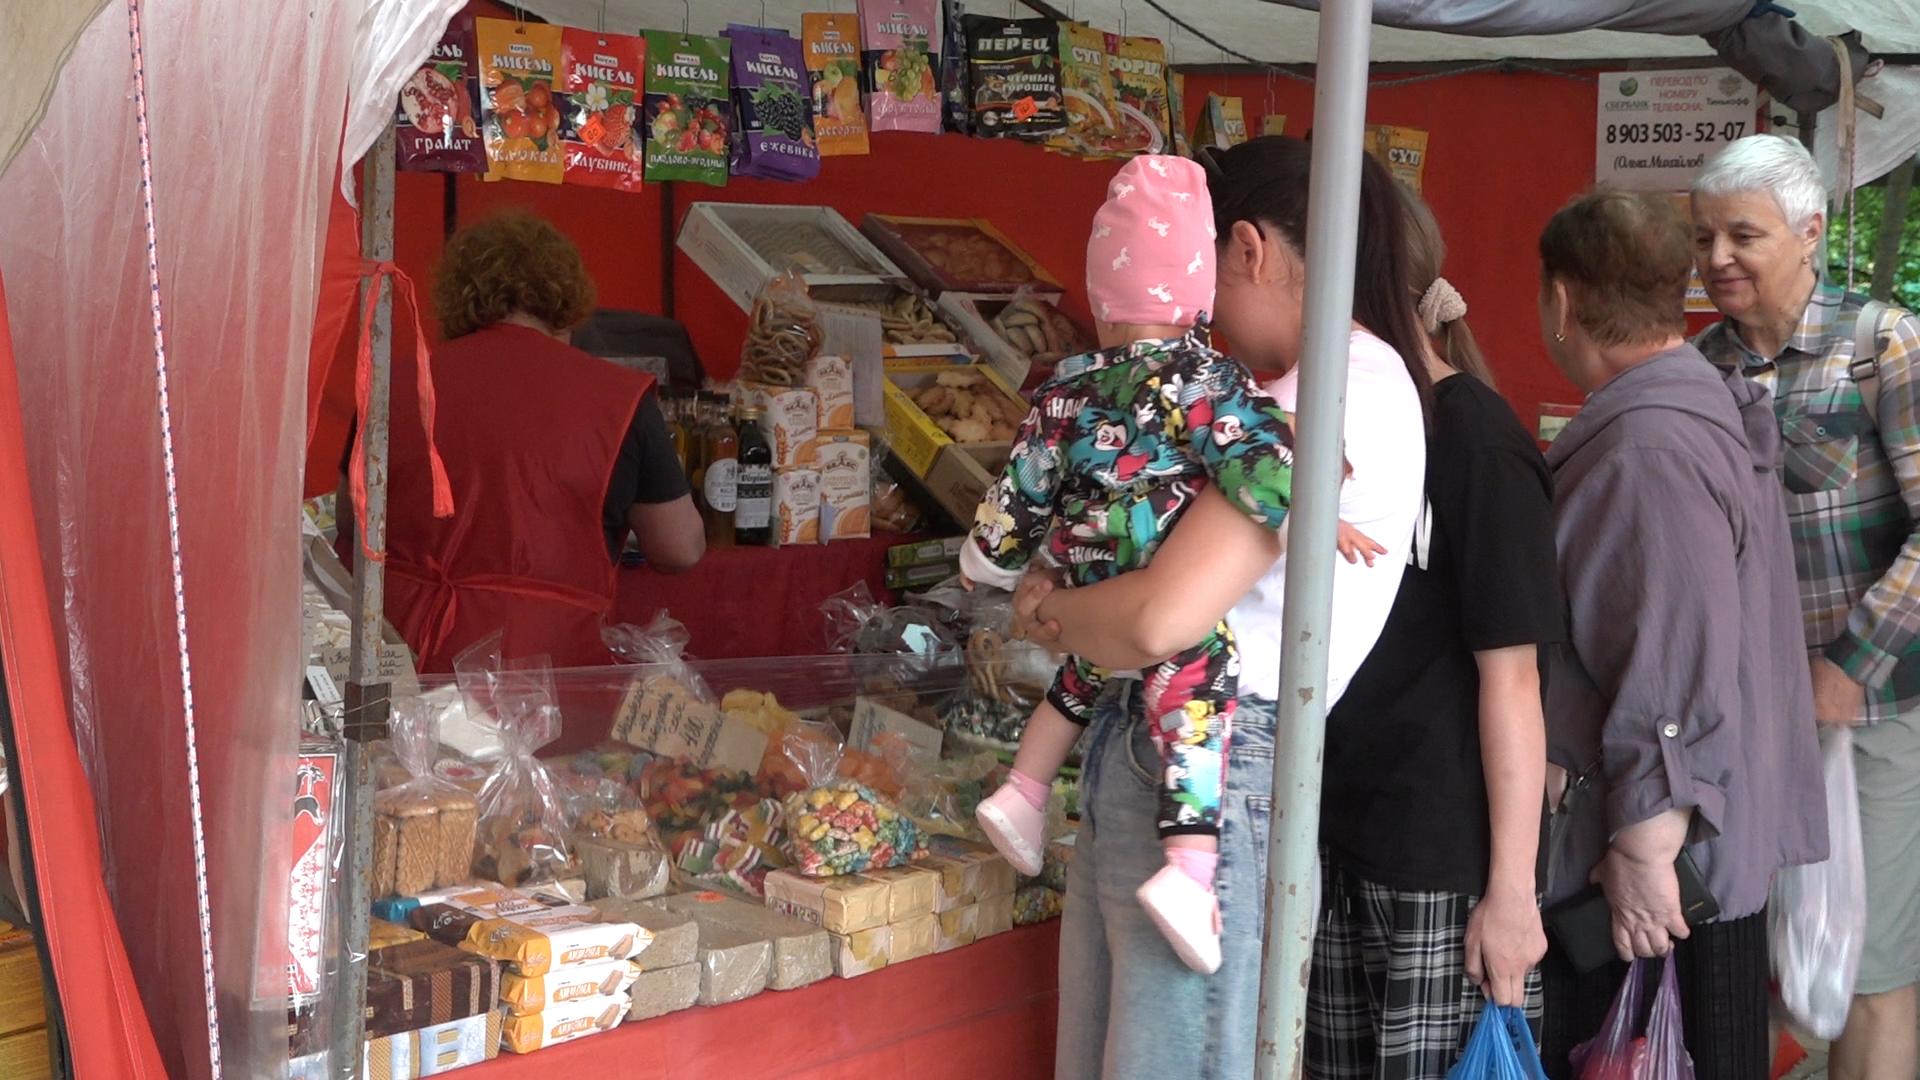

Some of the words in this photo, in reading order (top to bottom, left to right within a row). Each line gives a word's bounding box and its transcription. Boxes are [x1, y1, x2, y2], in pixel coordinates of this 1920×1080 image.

[811, 42, 855, 54] КИСЕЛЬ
[978, 38, 1051, 52] ПЕРЕЦ
[493, 54, 552, 72] КИСЕЛЬ
[575, 63, 635, 85] КИСЕЛЬ
[656, 63, 719, 81] КИСЕЛЬ
[746, 61, 799, 79] КИСЕЛЬ
[1651, 76, 1691, 87] ПЕРЕВОД
[1693, 75, 1708, 84] ПО
[1659, 89, 1698, 99] НОМЕРУ
[1605, 102, 1649, 110] СБЕРБАНК
[1652, 102, 1704, 112] ТЕЛЕФОНА:
[1706, 97, 1749, 106] Тинькофф
[1606, 124, 1617, 143] 8
[1619, 123, 1649, 143] 903
